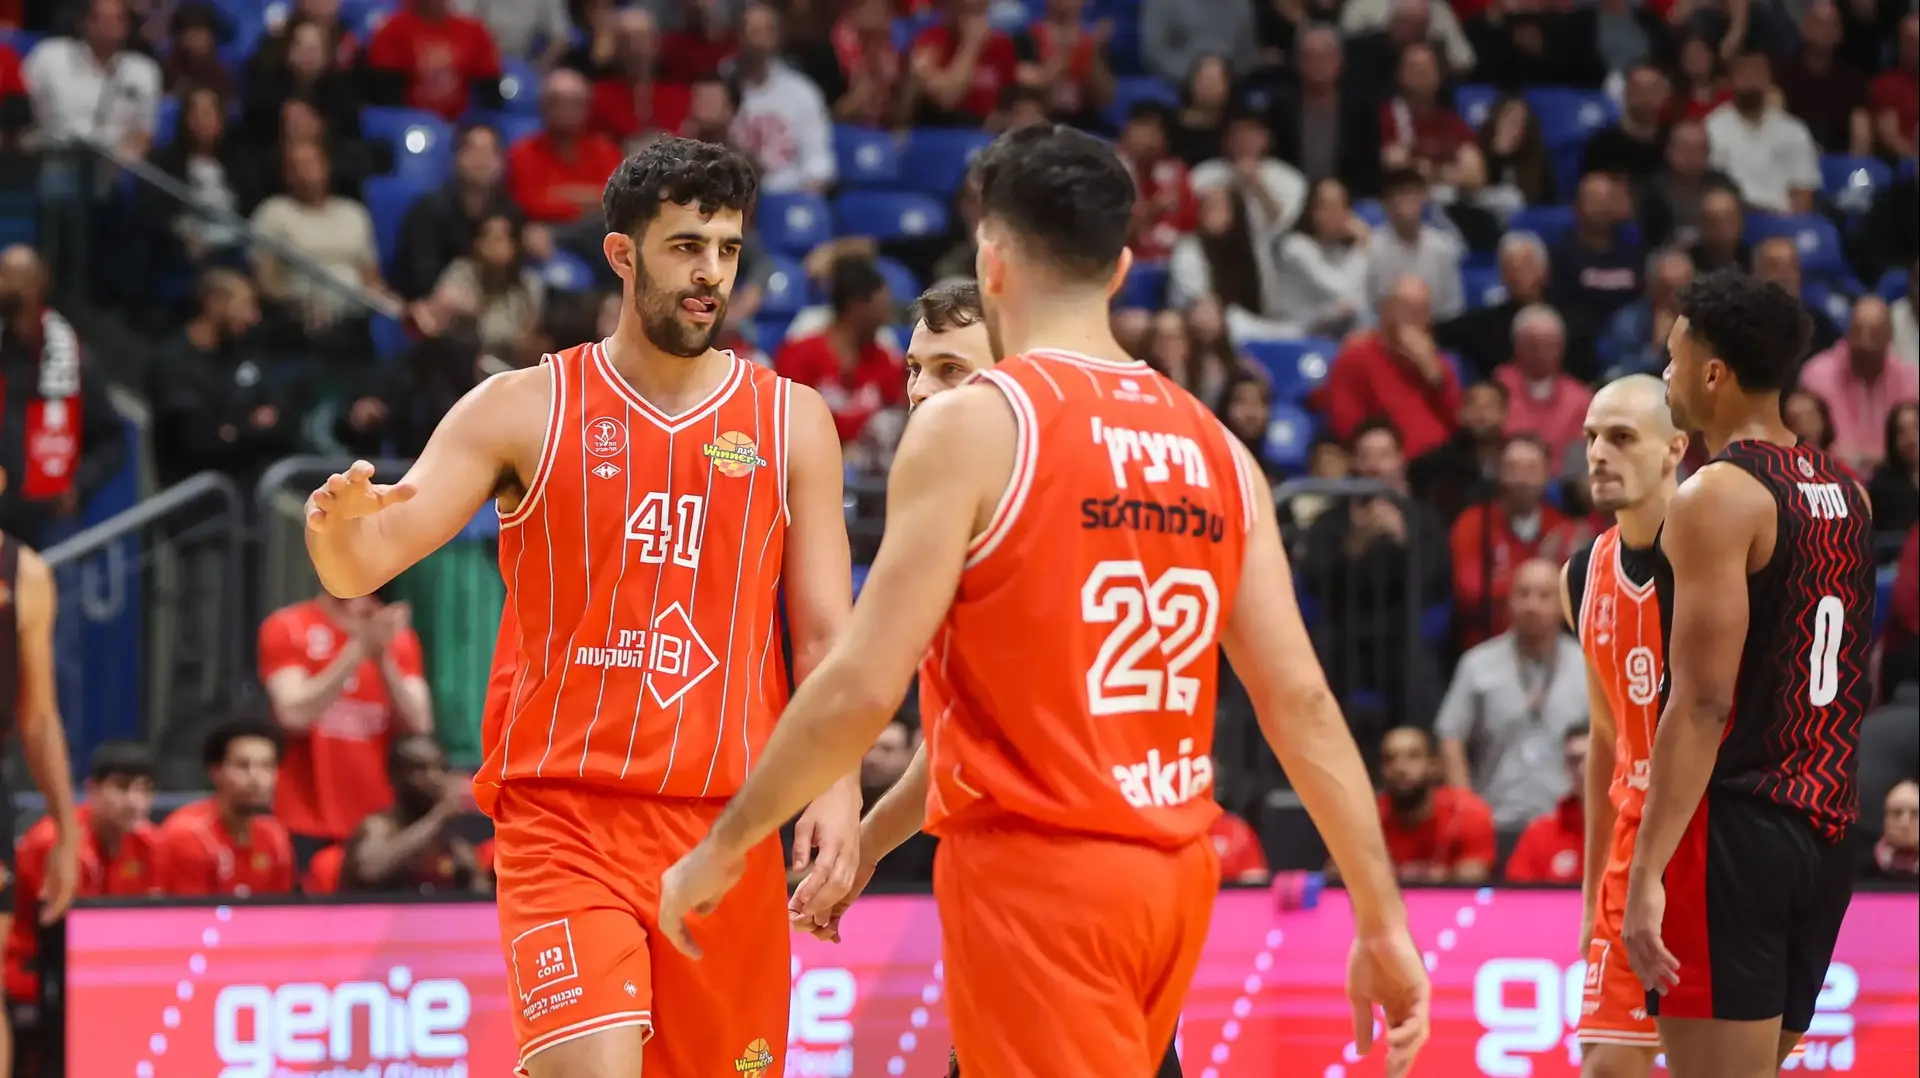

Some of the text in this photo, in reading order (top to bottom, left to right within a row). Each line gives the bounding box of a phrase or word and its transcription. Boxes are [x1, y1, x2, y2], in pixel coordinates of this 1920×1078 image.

[703, 443, 755, 464] Winner
[626, 492, 703, 569] 41
[574, 646, 644, 670] השקעות
[617, 629, 646, 648] בית
[648, 631, 691, 677] IBI
[1081, 560, 1220, 716] 22
[1809, 595, 1844, 707] 0
[1625, 646, 1657, 705] 9
[1111, 737, 1214, 808] arkia
[537, 961, 566, 979] com
[550, 986, 583, 1004] סוכנות
[214, 966, 471, 1078] genie
